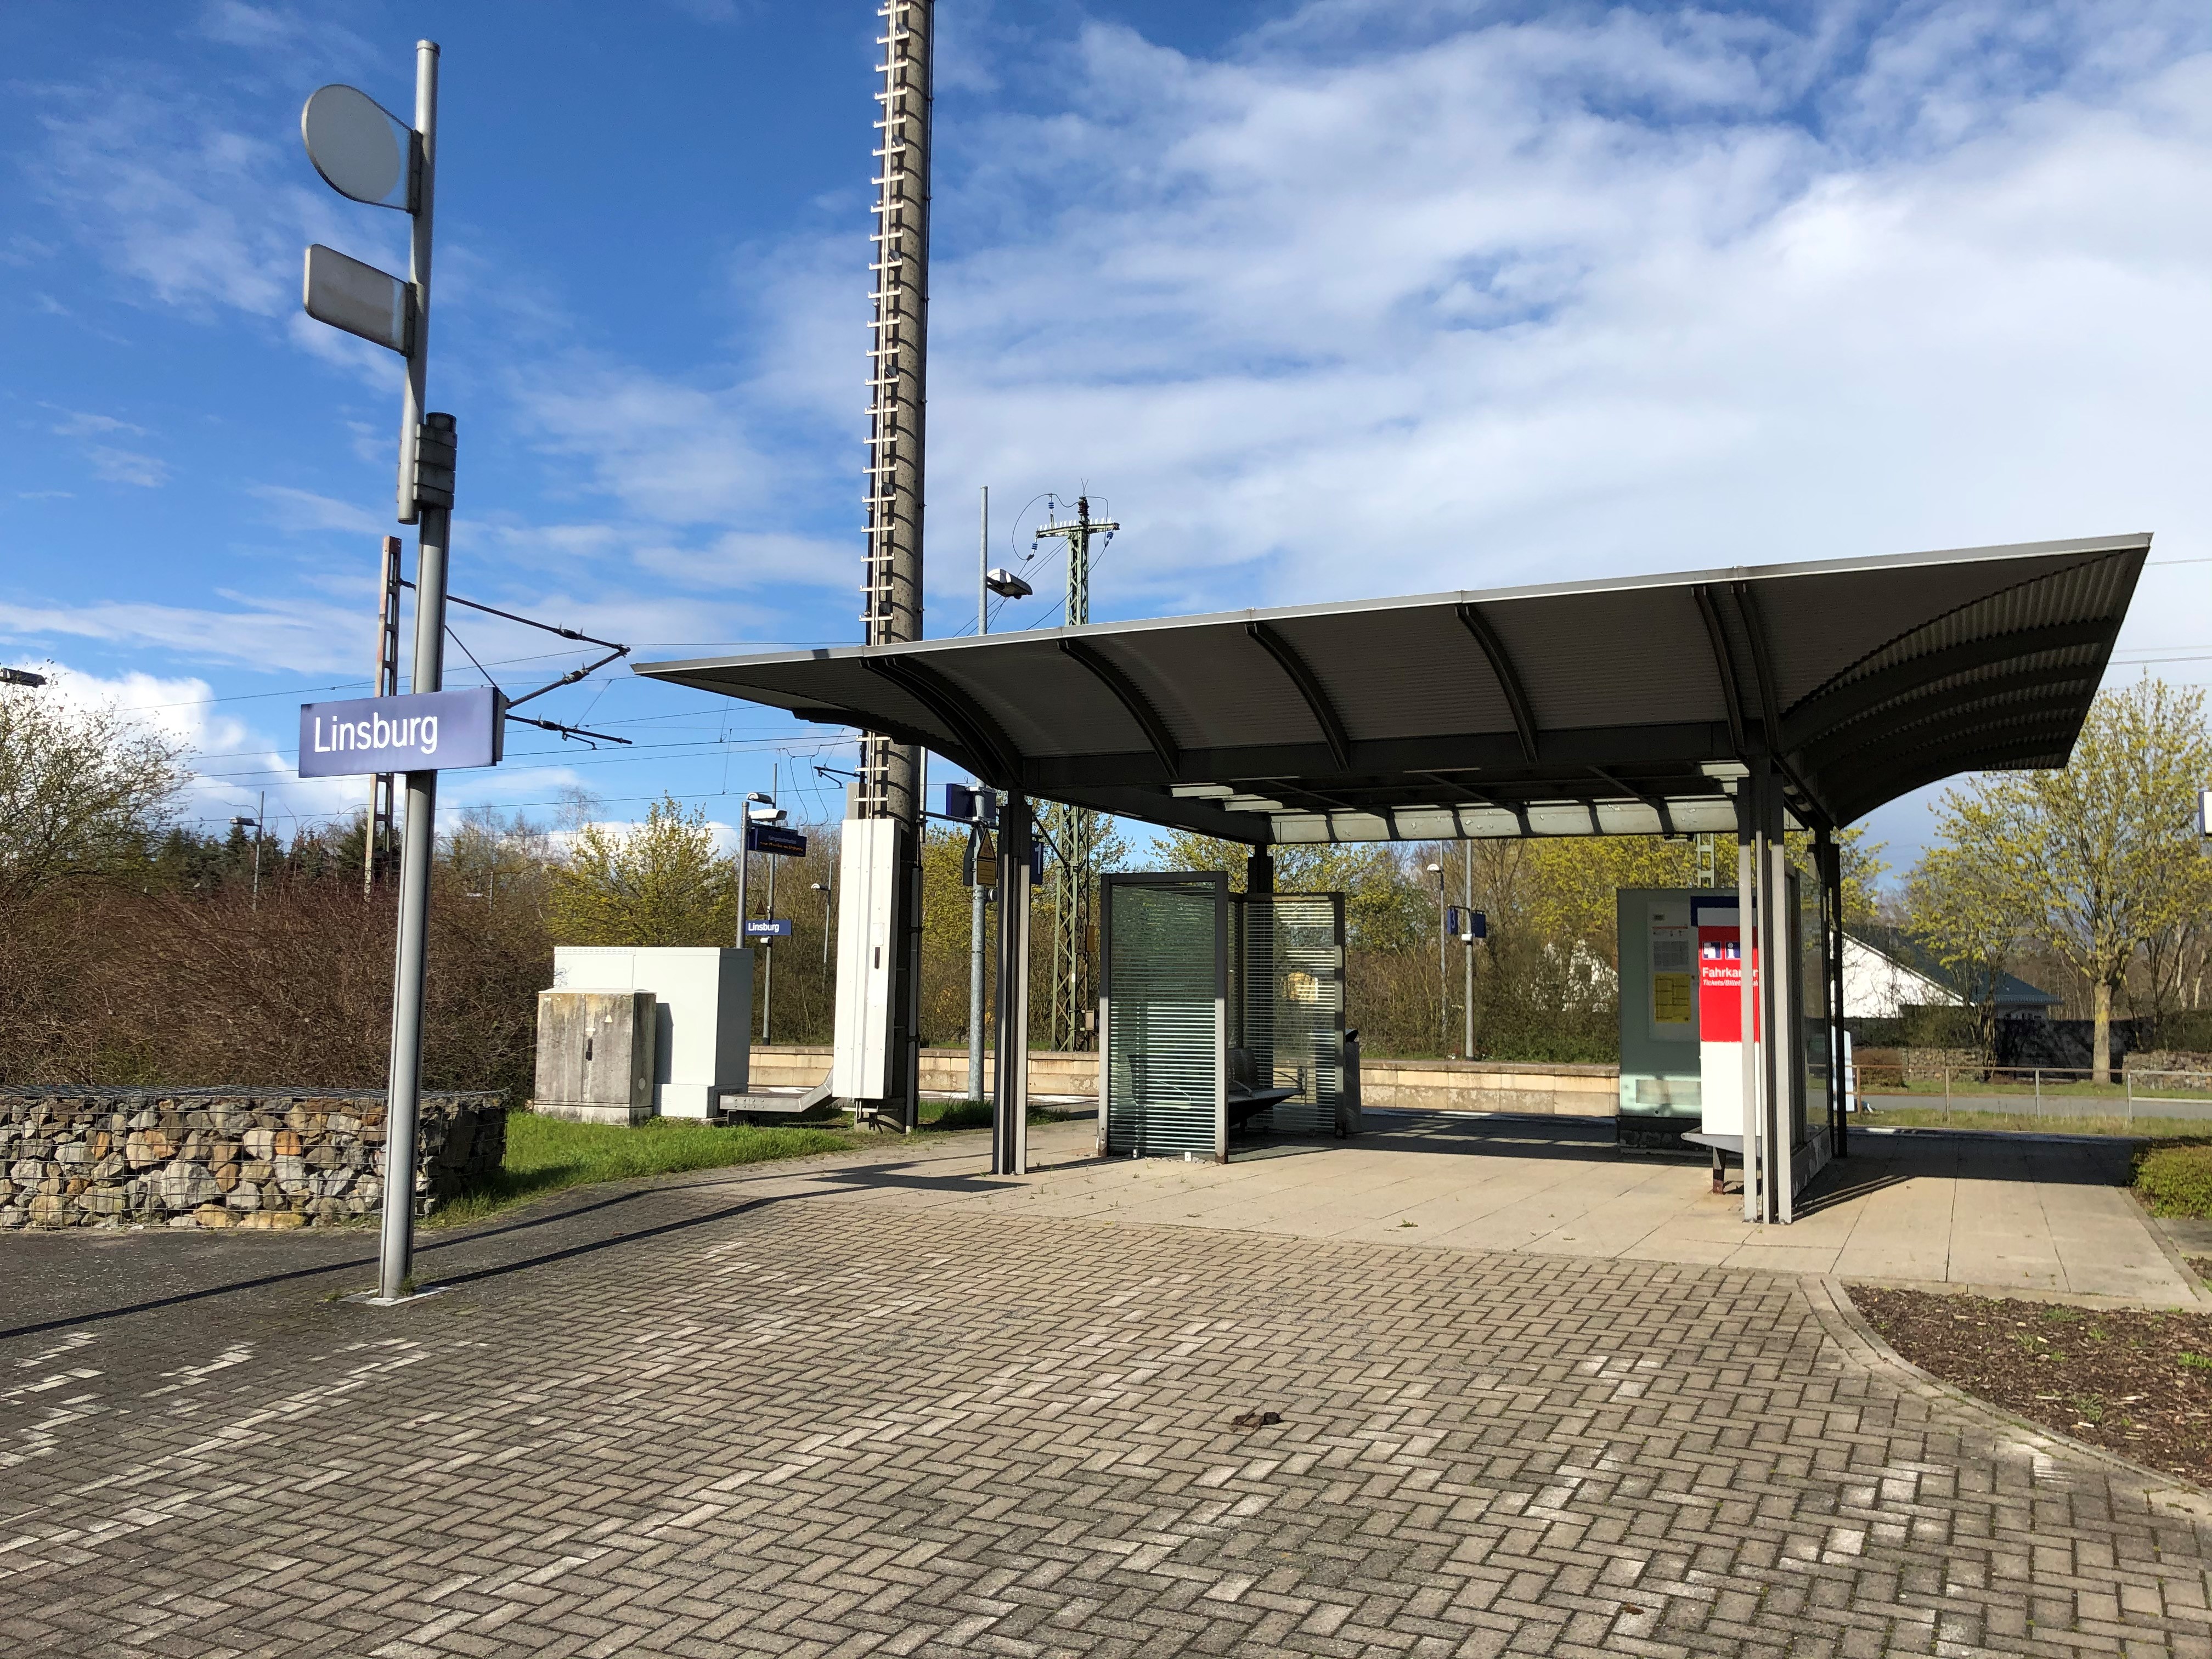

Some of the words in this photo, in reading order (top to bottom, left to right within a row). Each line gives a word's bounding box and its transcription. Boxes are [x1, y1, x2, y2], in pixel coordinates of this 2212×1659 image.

[314, 712, 438, 754] Linsburg
[1035, 843, 1041, 874] 1
[1075, 919, 1084, 934] 46
[1451, 910, 1455, 929] 3
[748, 922, 780, 933] Linsburg
[1077, 935, 1082, 950] 2
[1702, 967, 1758, 978] Fahrka
